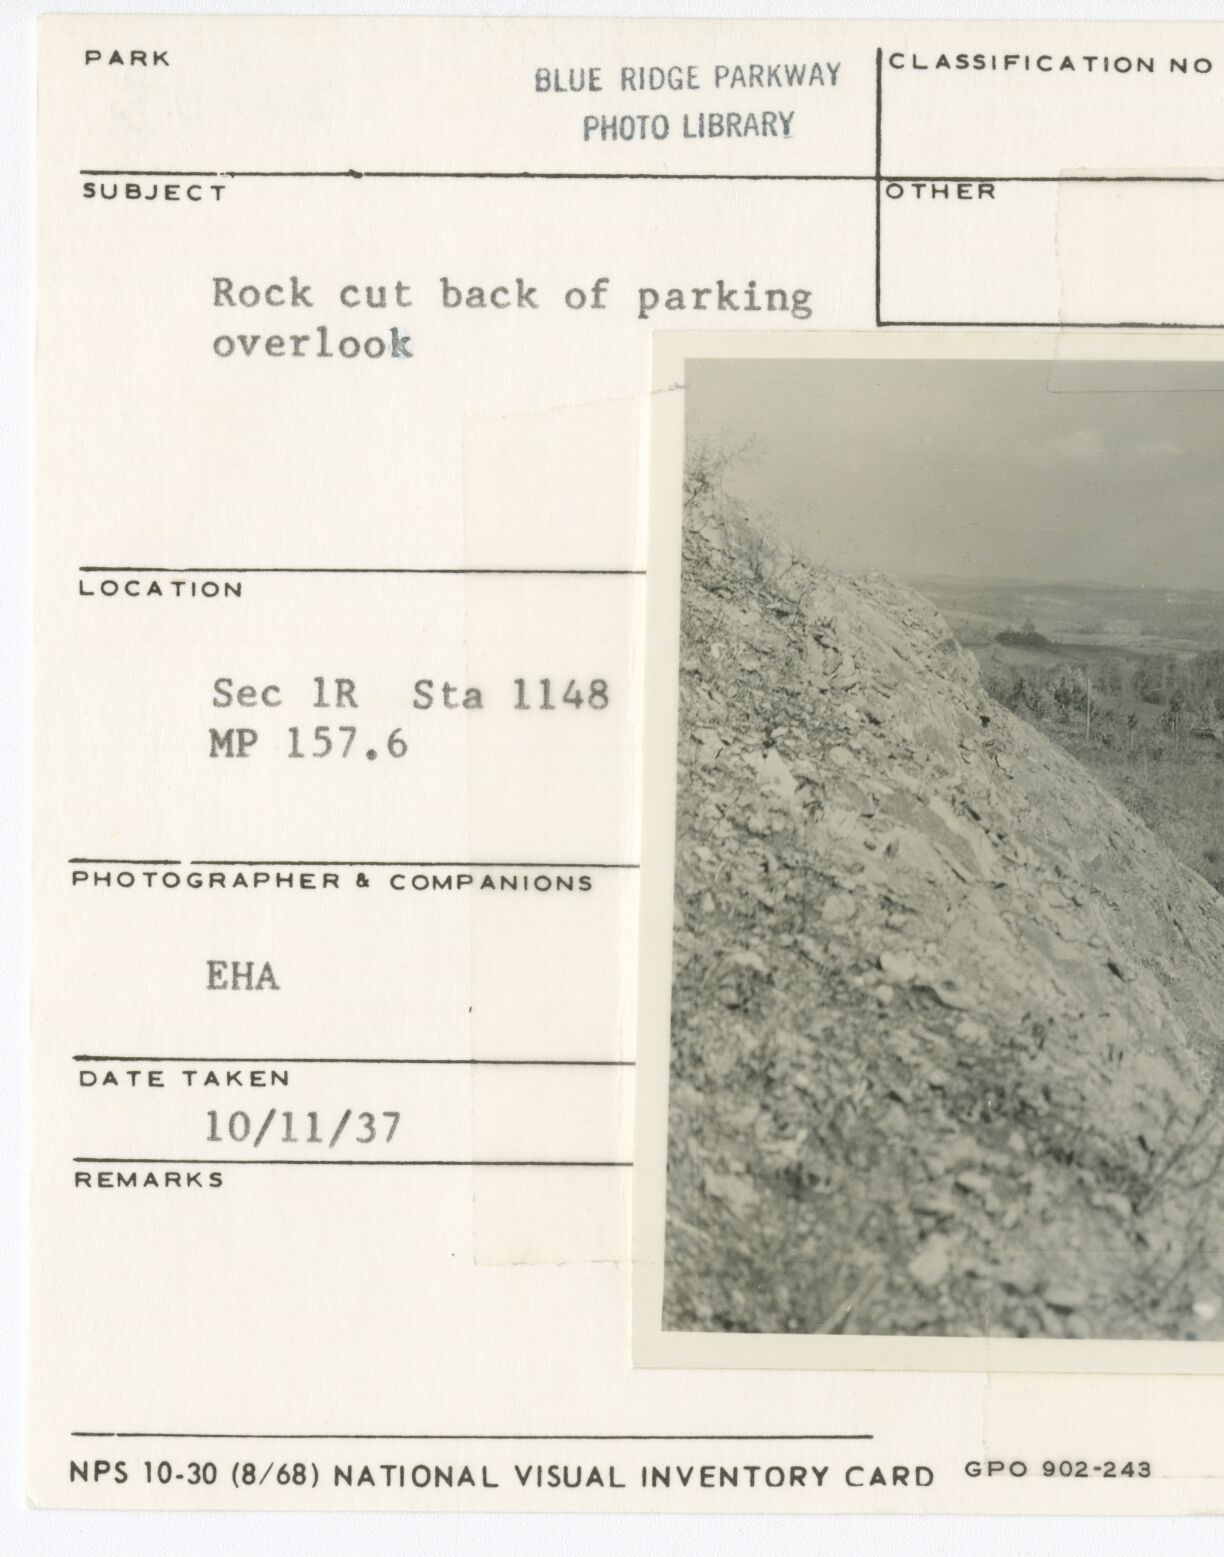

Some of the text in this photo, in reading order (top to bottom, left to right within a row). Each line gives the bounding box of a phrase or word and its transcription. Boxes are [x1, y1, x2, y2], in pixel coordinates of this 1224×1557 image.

[84, 48, 171, 68] PARK
[887, 51, 1214, 75] CLASSIFICATION NO
[534, 61, 842, 94] BLUE RIDGE PARKWAY
[582, 110, 796, 142] PHOTO LIBRARY
[81, 181, 227, 203] SUBJECT
[884, 179, 999, 202] OTHER
[211, 275, 813, 321] Rock cut back of parking
[212, 324, 413, 360] overlook
[78, 578, 243, 599] LOCATION
[212, 675, 610, 711] Sec 1R Sta 1148
[207, 725, 409, 762] MP 157.6
[71, 869, 593, 893] PHOTOGRAPHER & COMPANIONS
[205, 959, 281, 992] EHA
[78, 1069, 290, 1089] DATE TAKEN
[206, 1107, 401, 1149] 10/11/37
[73, 1170, 224, 1189] REMARKS
[68, 1458, 935, 1490] NPS 10-30 (8/68) NATIONAL VISUAL INVENTORY CARD
[963, 1459, 1152, 1480] GPO 902-243
